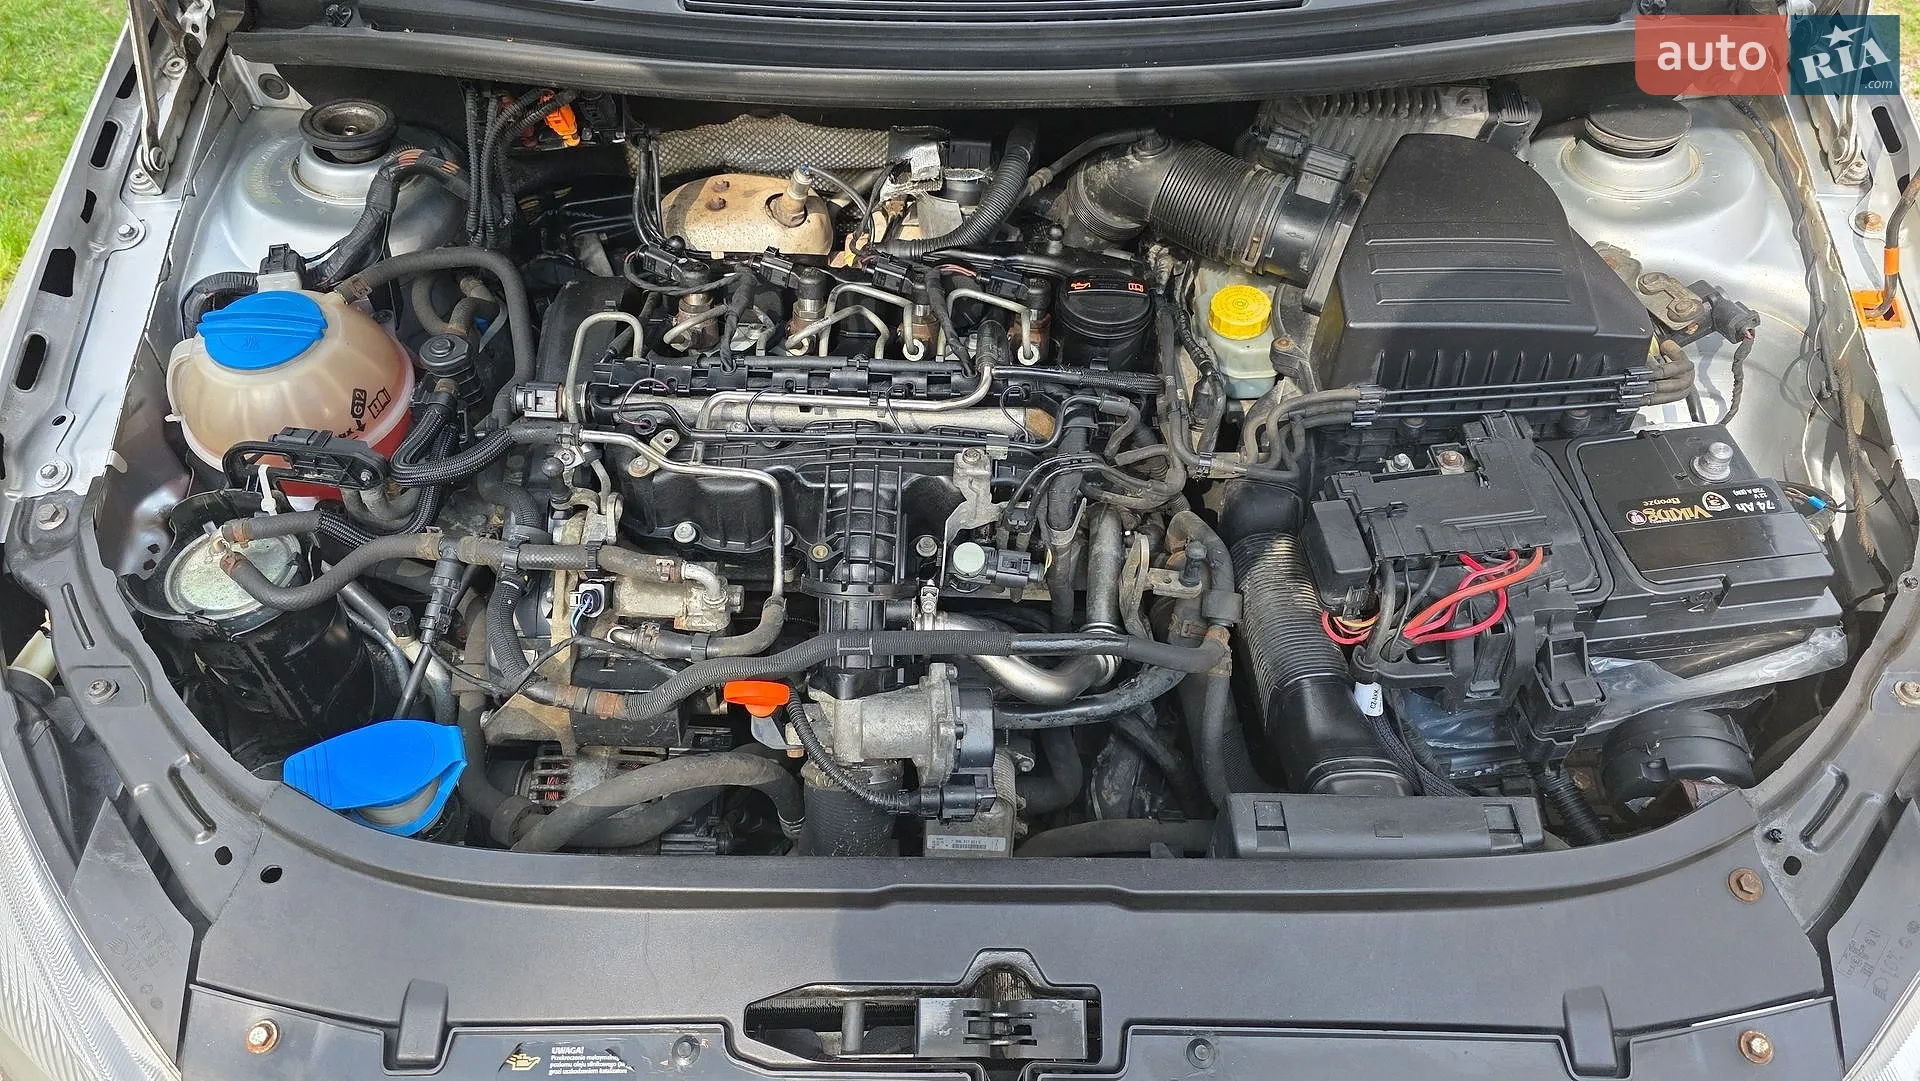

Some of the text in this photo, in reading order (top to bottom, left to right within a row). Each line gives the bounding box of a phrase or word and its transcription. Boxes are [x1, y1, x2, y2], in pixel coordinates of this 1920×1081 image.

[353, 391, 365, 415] G12
[1642, 497, 1681, 507] Bronze
[1735, 500, 1776, 513] 74 Ah
[551, 1046, 585, 1055] UWAGA!
